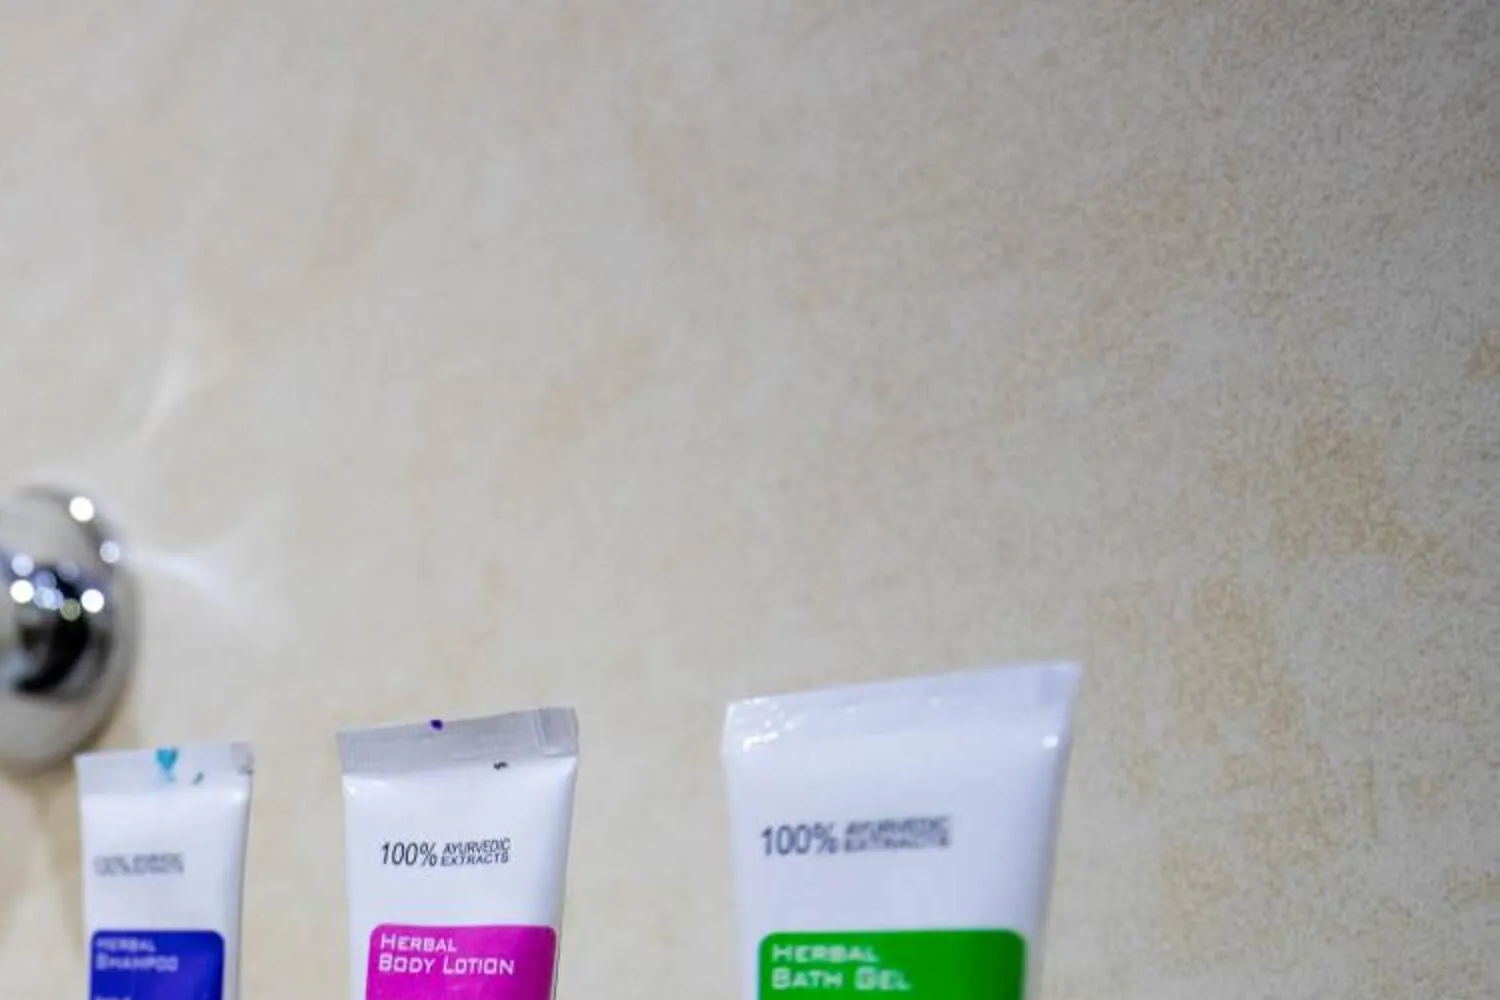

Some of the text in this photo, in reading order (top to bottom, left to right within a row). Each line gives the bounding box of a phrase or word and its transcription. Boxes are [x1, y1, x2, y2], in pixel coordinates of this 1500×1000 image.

[443, 837, 511, 854] AYURVEDIC
[761, 822, 837, 856] 100%
[380, 841, 437, 867] 100%
[441, 851, 509, 867] EXTRACTS
[380, 933, 457, 953] HERBAL
[772, 944, 879, 963] HERBAL
[378, 953, 515, 975] BODY LOTION
[771, 967, 912, 991] BATH GEL
